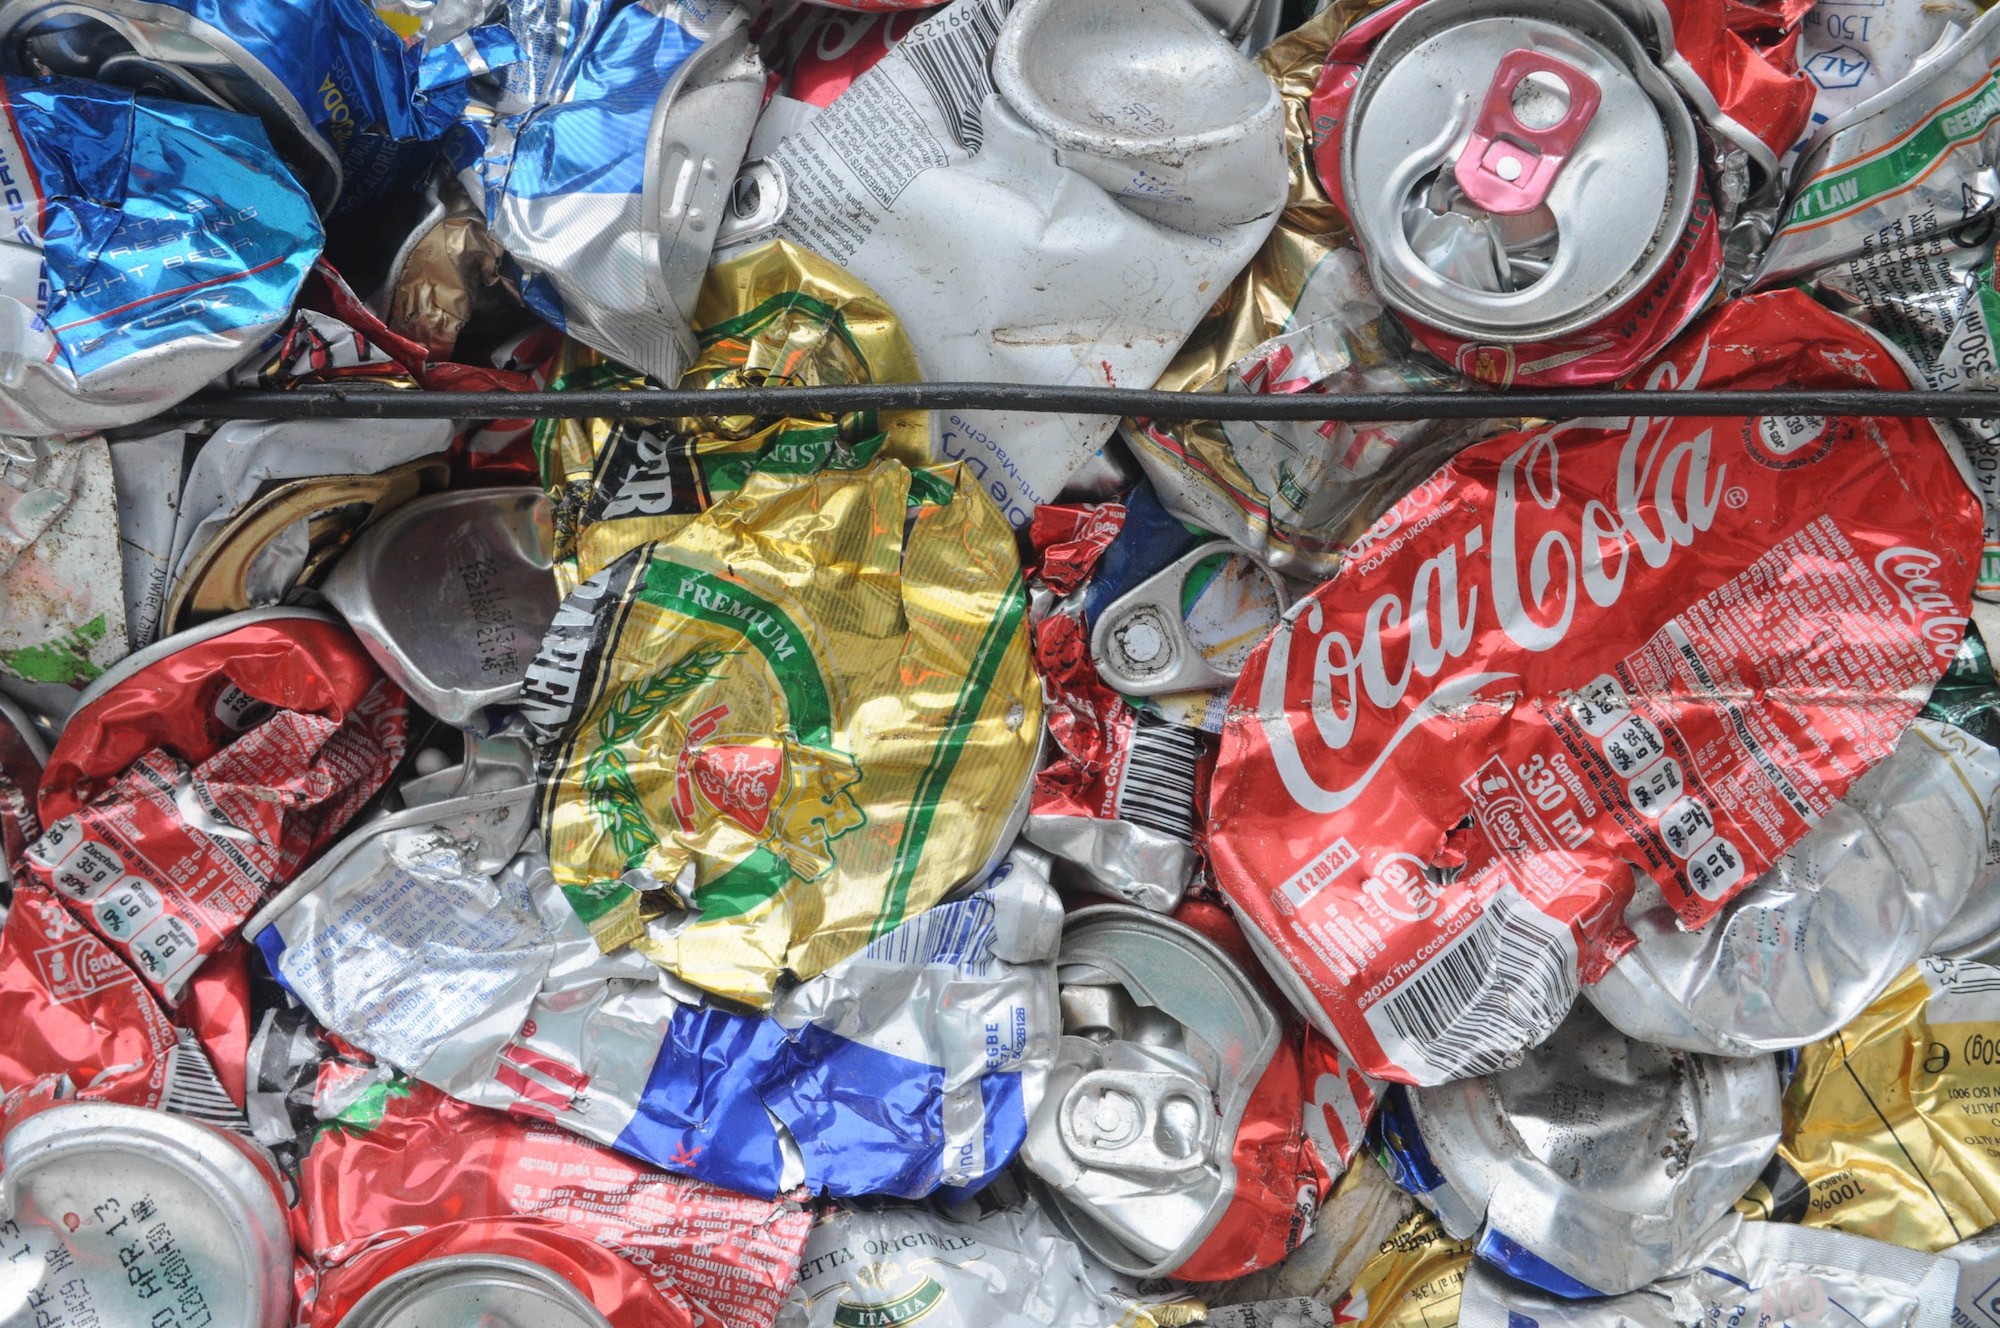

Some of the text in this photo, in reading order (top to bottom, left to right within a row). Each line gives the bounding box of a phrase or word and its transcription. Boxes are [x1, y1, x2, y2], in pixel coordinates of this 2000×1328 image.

[1825, 10, 1872, 42] 150
[1817, 54, 1863, 80] AL
[811, 152, 828, 170] bene
[823, 167, 846, 192] Agitare
[1814, 175, 1862, 212] LAW
[799, 201, 813, 216] una
[828, 208, 865, 249] spruzzare
[162, 236, 254, 269] BEER
[809, 224, 849, 270] Conservare
[1957, 333, 1995, 377] 330
[1358, 499, 1452, 576] POLAND-UKRAINE
[1794, 530, 1817, 557] acido
[1805, 520, 1839, 563] anidride
[1817, 513, 1853, 559] BEVANDA
[1257, 338, 1727, 813] Coca-Cola
[1696, 596, 1720, 623] della
[1715, 584, 1735, 606] HBC
[677, 578, 798, 662] PREMIUM
[1685, 604, 1728, 660] Conservare
[1706, 590, 1721, 606] Da
[1715, 606, 1762, 666] consumarsi
[1839, 650, 1860, 674] vedi
[1576, 702, 1596, 726] 7%
[1622, 728, 1640, 748] 35
[1547, 751, 1601, 817] Contenuto
[1099, 789, 1114, 816] The
[1514, 754, 1594, 848] 330 ml
[76, 854, 97, 874] 35
[83, 837, 122, 880] Zuccheri
[61, 870, 87, 899] 39%
[130, 879, 157, 910] Grassi
[101, 907, 125, 932] 0%
[126, 904, 141, 917] g
[161, 944, 176, 958] g
[1392, 911, 1478, 980] The Coca-Cola
[980, 1020, 1003, 1067] EGBE
[1946, 1085, 1989, 1100] ISO 9001
[1963, 1134, 1992, 1146] ALTO
[1811, 1178, 1865, 1212] 100%
[1814, 1167, 1853, 1191] ARABICA
[92, 1196, 164, 1300] APR 13
[862, 1219, 975, 1268] ORIGINALE
[1408, 1278, 1448, 1302] al 1,3%
[855, 1295, 927, 1328] ITALIA
